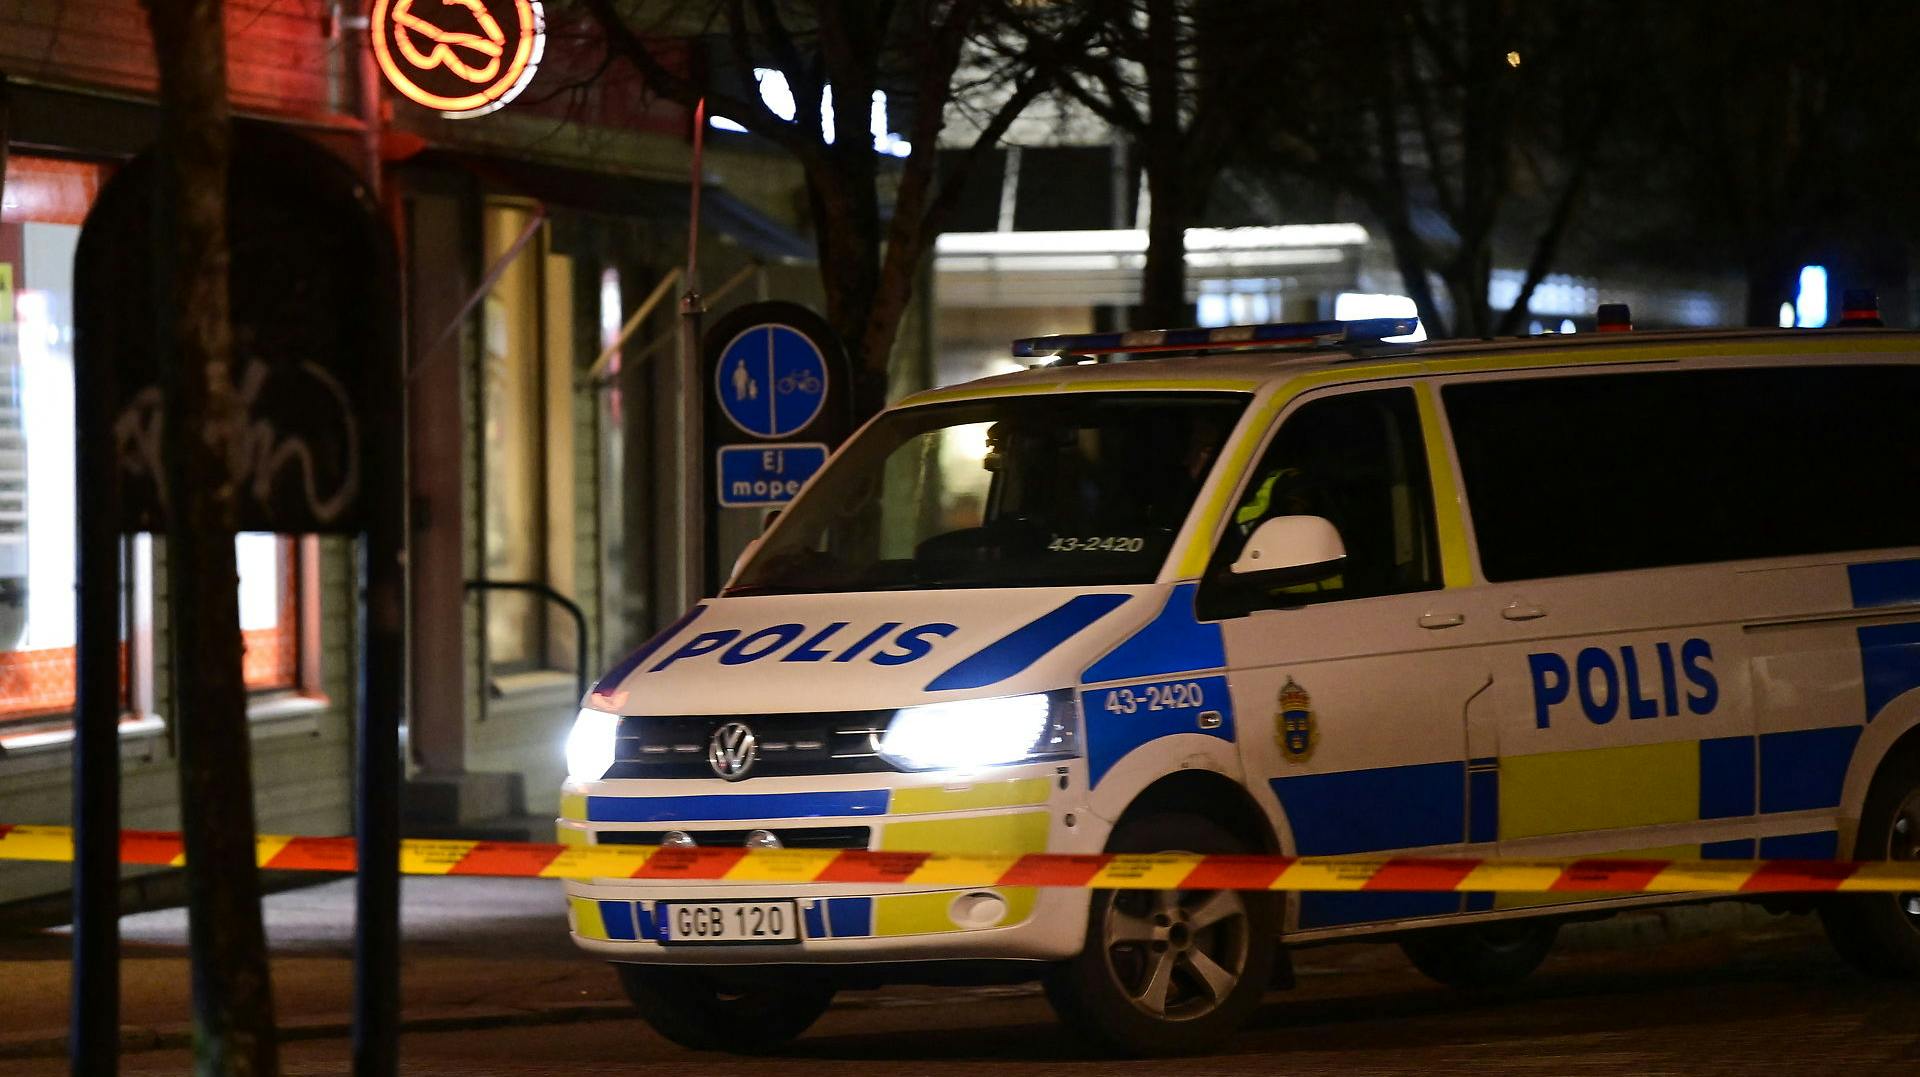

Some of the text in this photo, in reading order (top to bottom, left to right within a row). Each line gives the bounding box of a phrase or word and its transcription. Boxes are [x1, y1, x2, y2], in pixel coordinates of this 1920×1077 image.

[763, 449, 784, 474] Ej
[733, 480, 803, 499] mope
[1048, 536, 1144, 552] 43-2420
[647, 622, 959, 673] POLIS
[1104, 682, 1204, 715] 43-2420
[1528, 638, 1719, 729] POLIS
[677, 905, 784, 937] GGB 120
